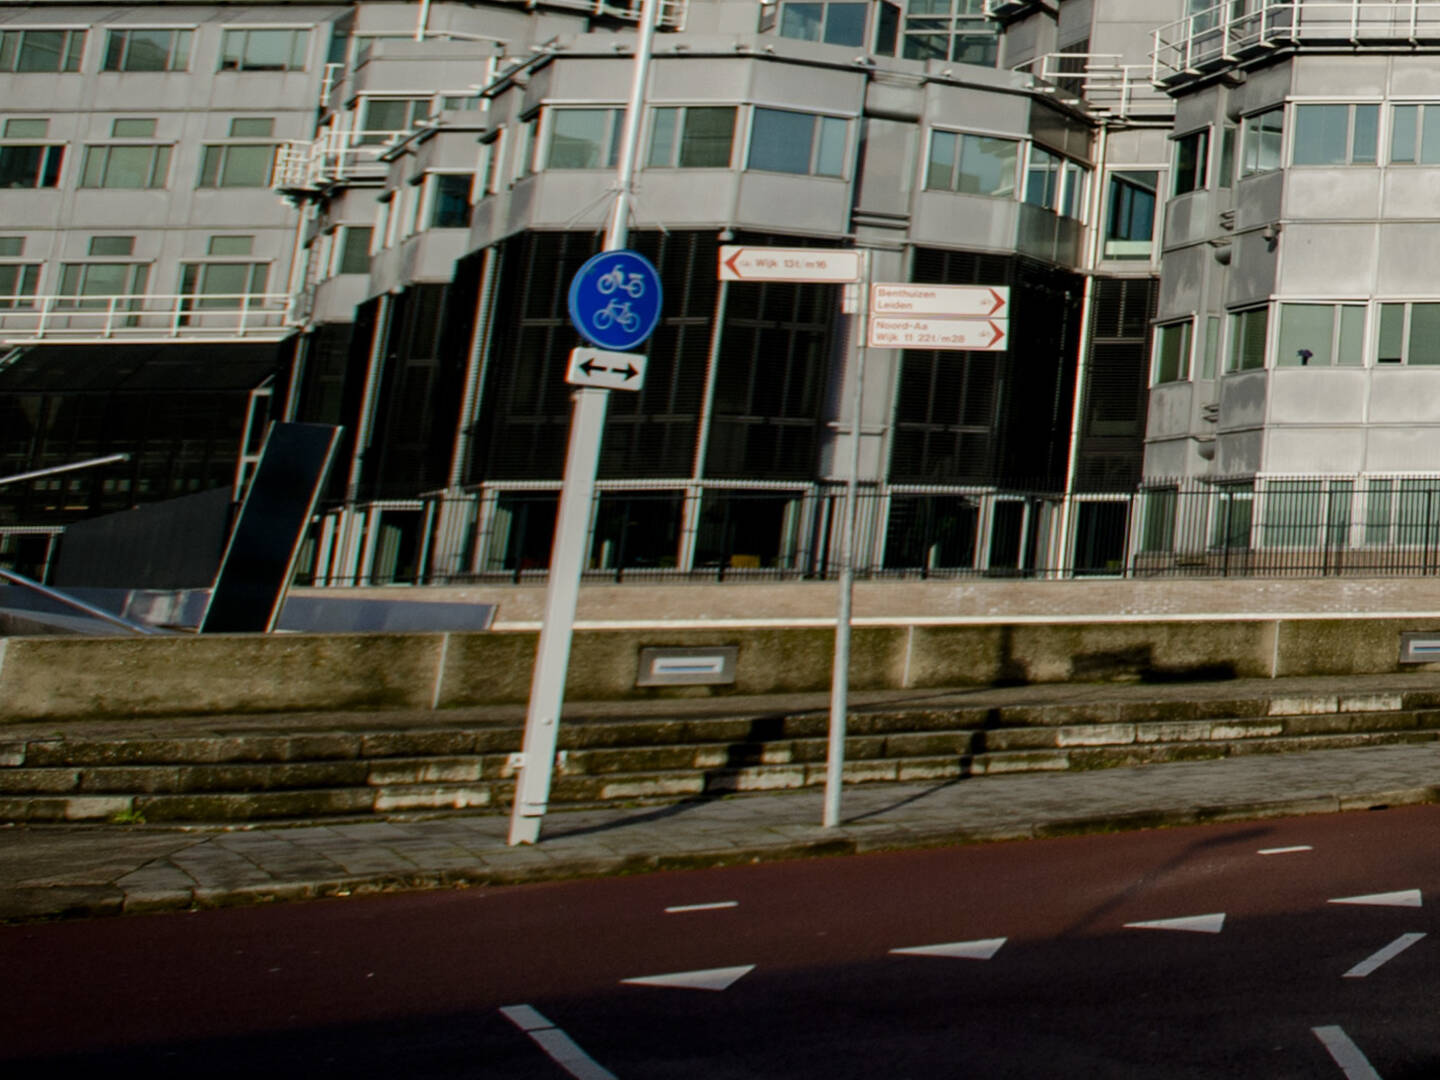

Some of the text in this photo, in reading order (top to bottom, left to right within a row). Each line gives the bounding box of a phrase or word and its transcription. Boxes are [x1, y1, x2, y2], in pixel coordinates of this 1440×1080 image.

[756, 259, 777, 270] Wijk
[878, 288, 936, 299] Benthuizen
[878, 301, 912, 310] Leiden
[877, 333, 898, 343] Wijk
